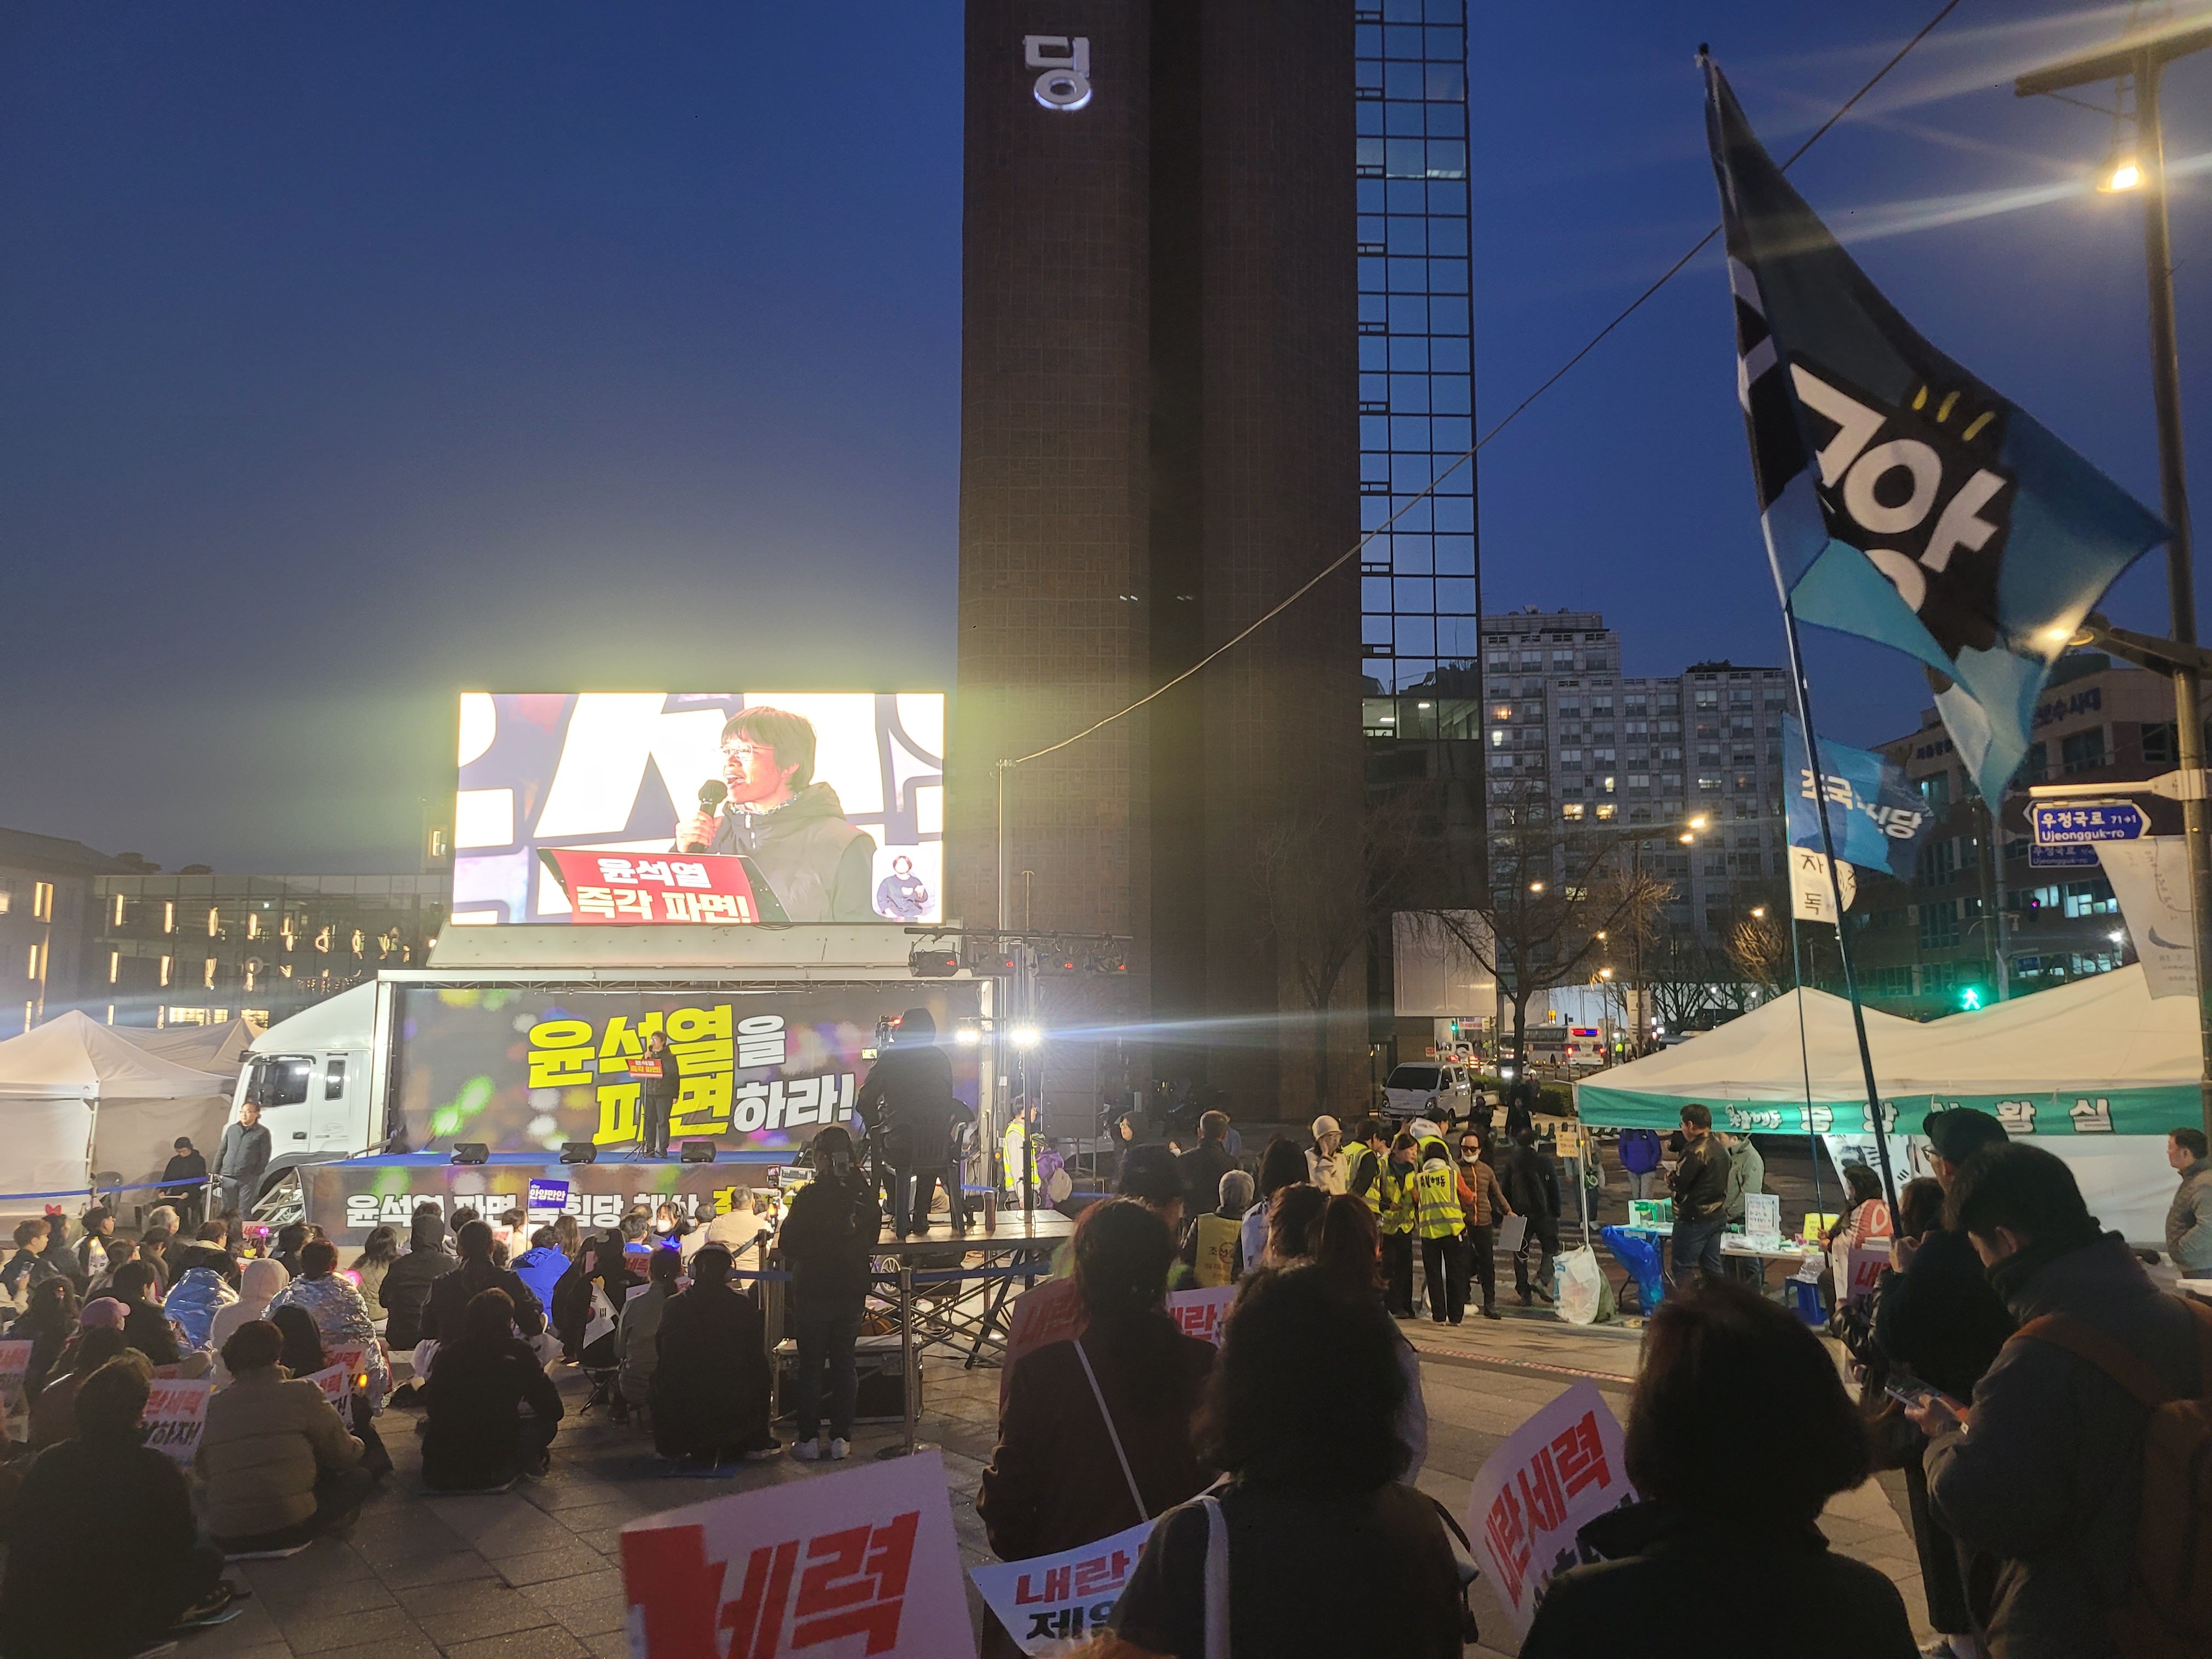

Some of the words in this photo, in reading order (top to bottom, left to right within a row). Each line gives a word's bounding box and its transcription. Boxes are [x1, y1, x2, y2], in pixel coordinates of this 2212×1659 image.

[2040, 811, 2106, 829] 우정국로
[2041, 828, 2125, 842] Ujeongguk-ro
[597, 857, 712, 889] 윤석열
[575, 885, 654, 921] 즉각
[661, 891, 751, 924] 파면!
[529, 1188, 566, 1201] 안양만안
